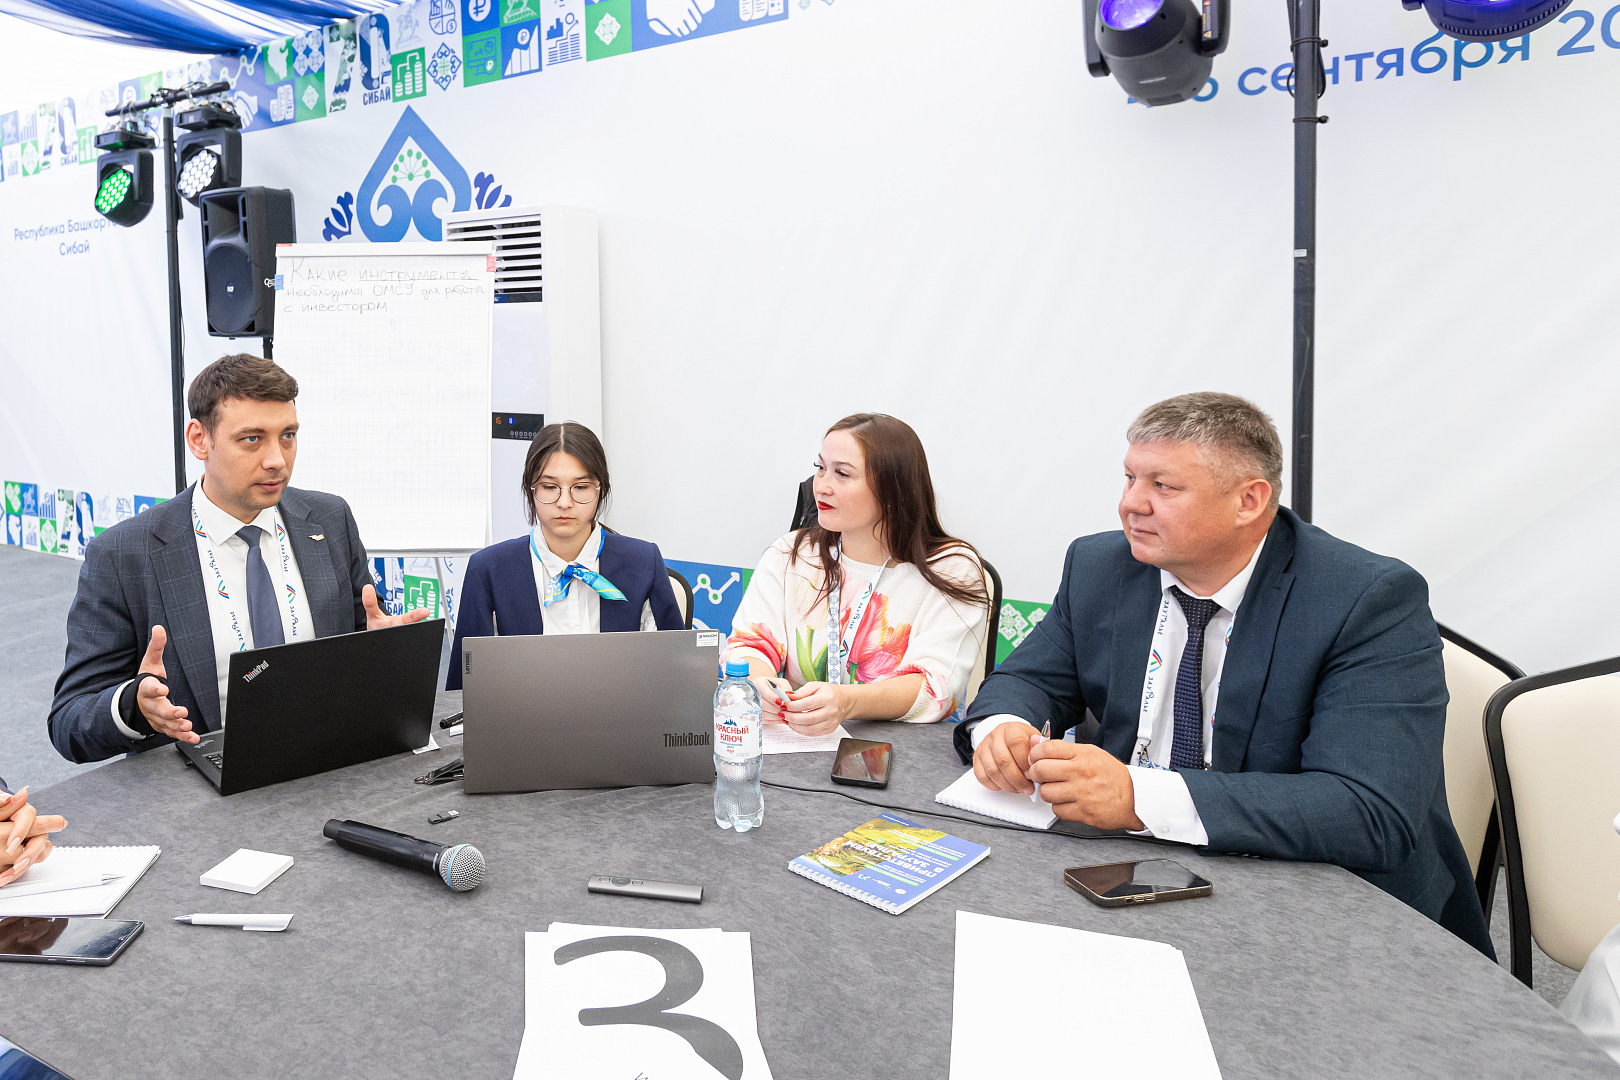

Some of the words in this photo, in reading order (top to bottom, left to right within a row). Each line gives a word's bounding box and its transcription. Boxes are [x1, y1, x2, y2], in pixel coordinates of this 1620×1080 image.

[362, 86, 391, 106] СИБАЙ
[14, 223, 65, 241] Республика
[59, 240, 90, 255] Сибай
[421, 288, 441, 301] для
[301, 302, 388, 314] инвестором
[384, 602, 403, 616] БАЙ
[242, 660, 270, 683] ThinkPad
[715, 722, 750, 735] КРАСНЫЙ
[663, 731, 711, 748] ThinkBook
[720, 733, 743, 743] КЛЮЧ
